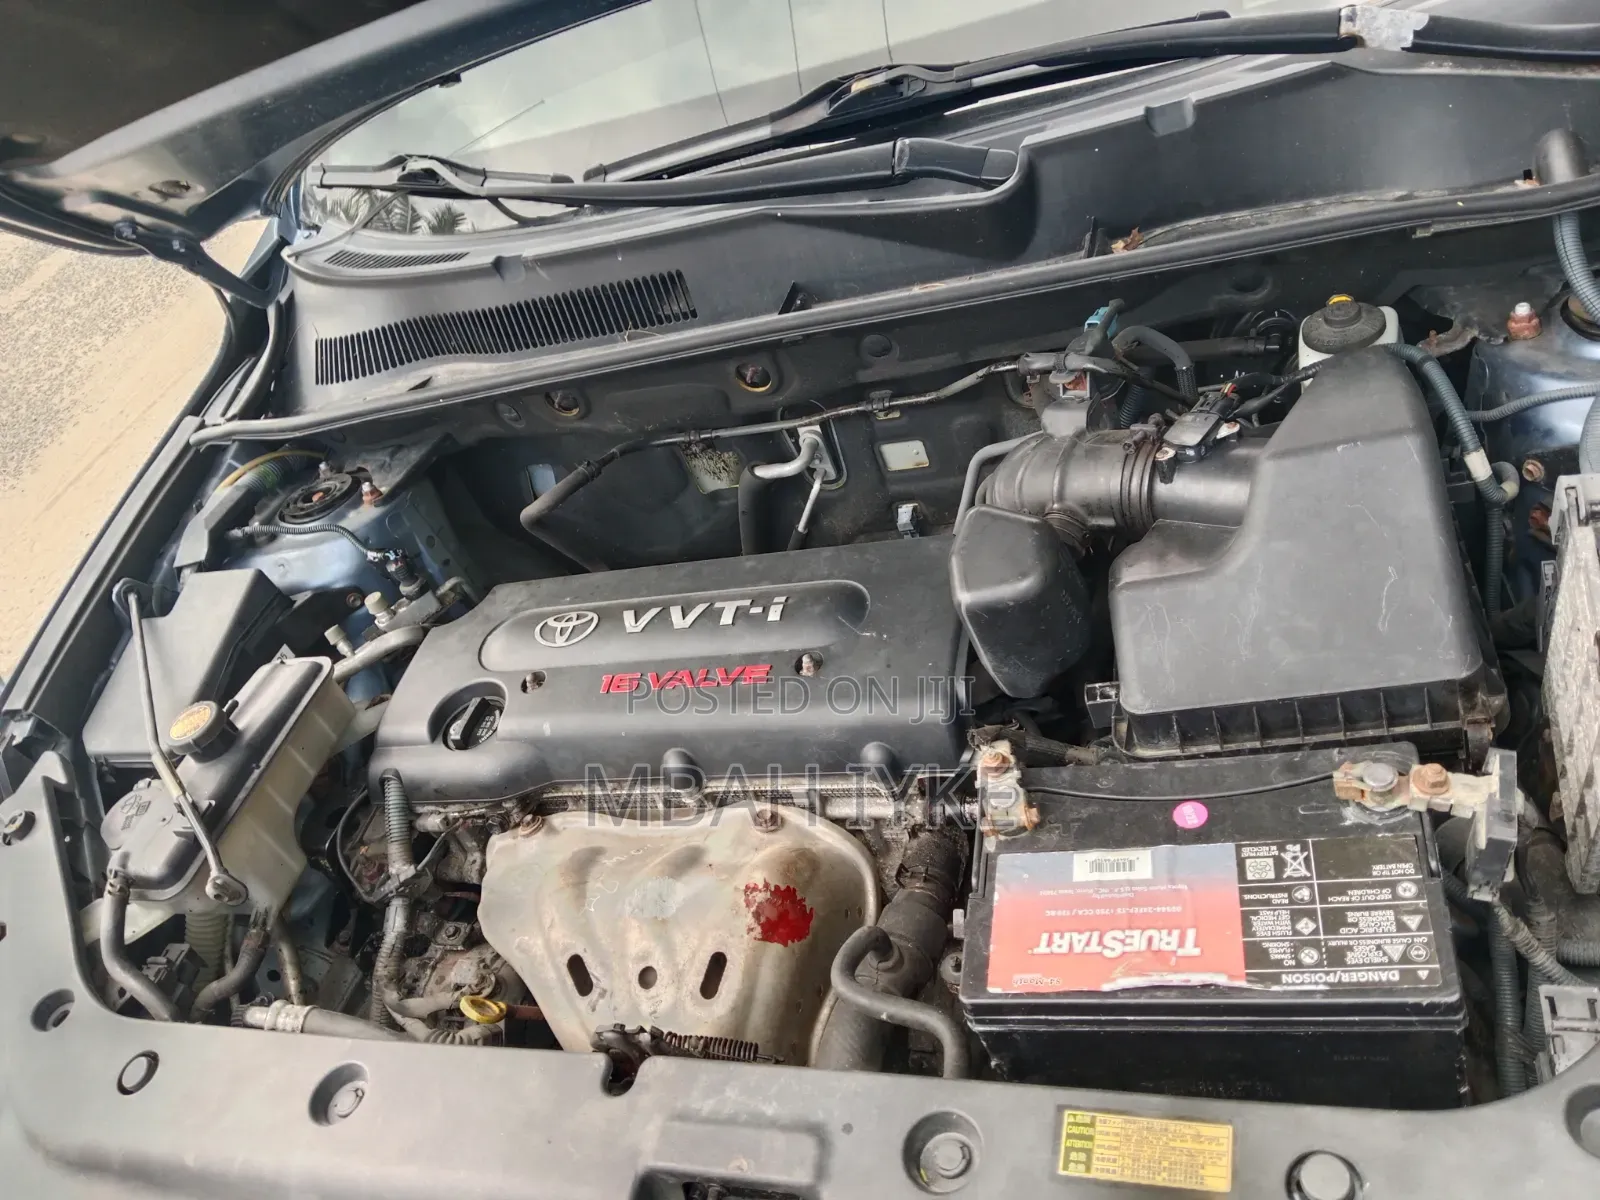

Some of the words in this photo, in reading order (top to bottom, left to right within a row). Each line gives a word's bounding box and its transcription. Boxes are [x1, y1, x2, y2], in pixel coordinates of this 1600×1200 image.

[622, 596, 788, 633] VVT-i
[600, 672, 642, 694] 16
[647, 664, 772, 690] VALVE
[1353, 944, 1376, 952] GASES
[1346, 950, 1383, 958] EXPLOSIVE
[1364, 956, 1388, 964] SHIELD
[1282, 970, 1400, 983] DANGER/POISON
